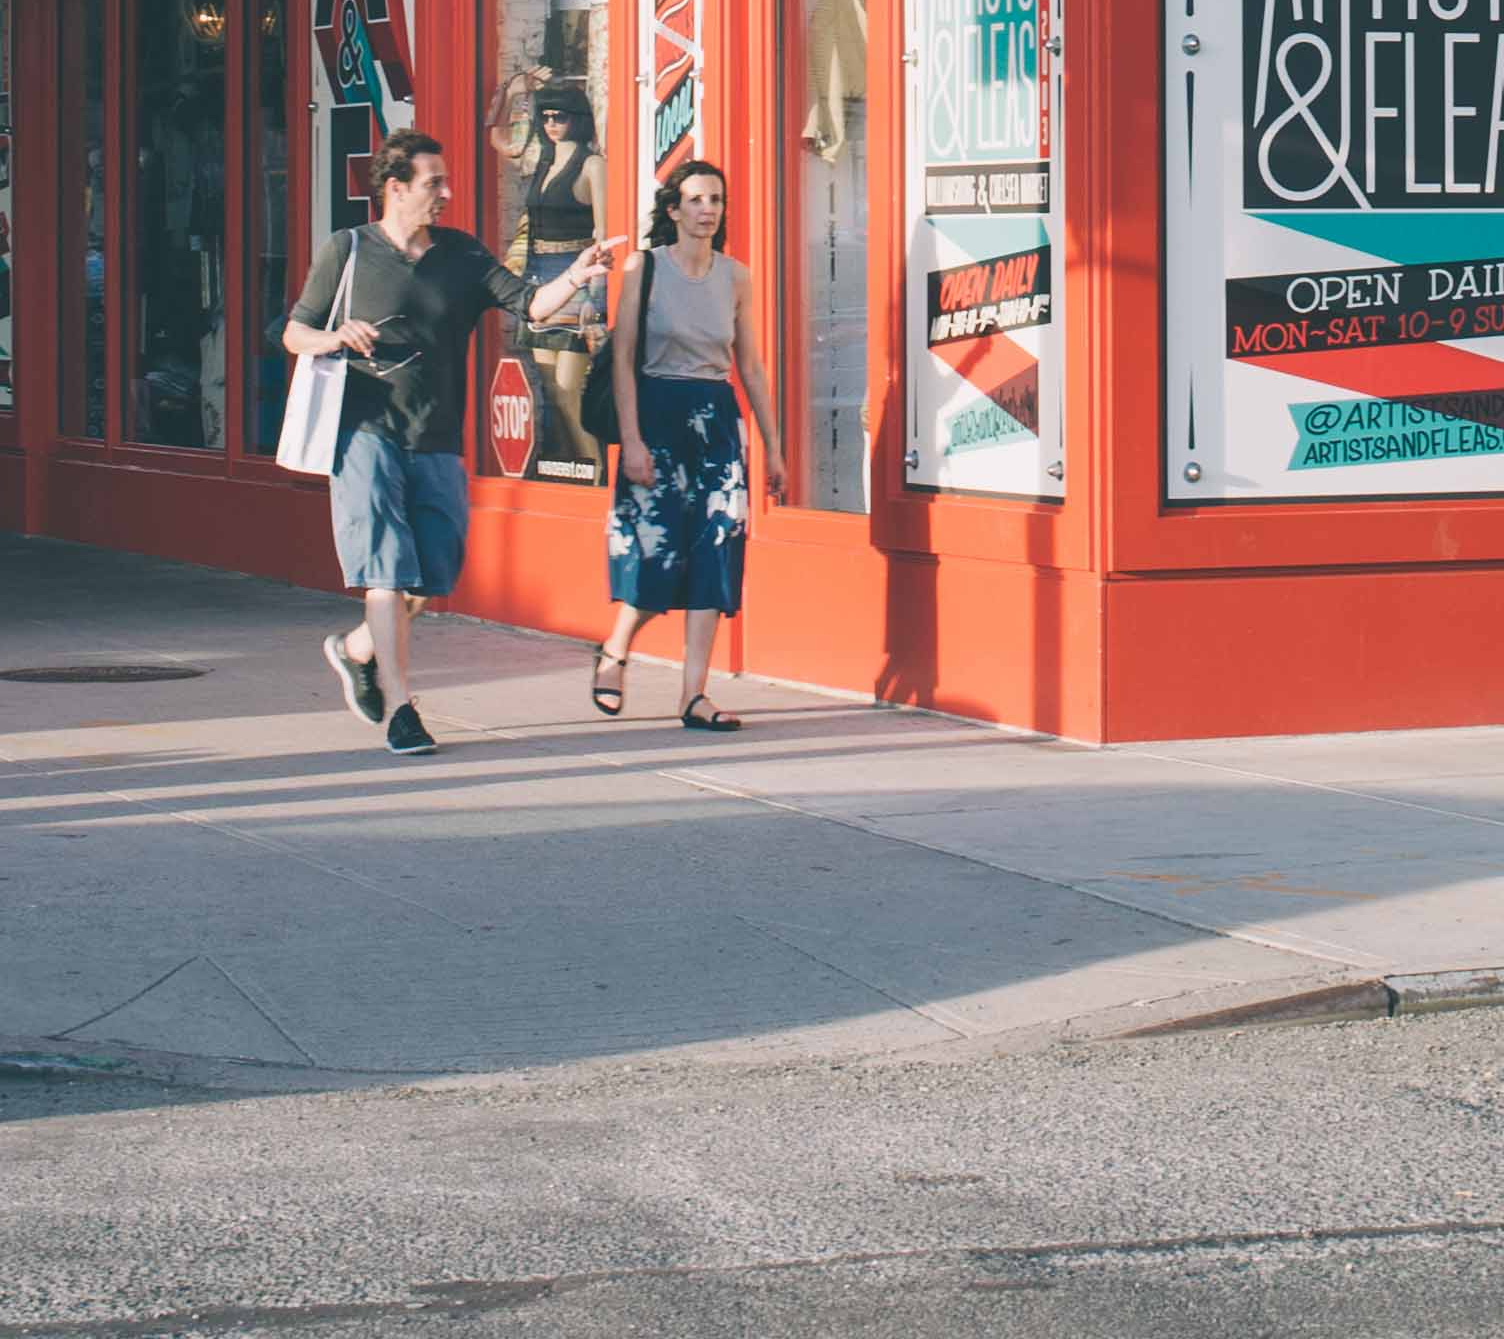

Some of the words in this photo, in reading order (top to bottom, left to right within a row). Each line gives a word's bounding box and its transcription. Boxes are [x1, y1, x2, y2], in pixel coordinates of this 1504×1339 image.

[963, 20, 1035, 154] FLEAS
[1258, 32, 1373, 209] &
[939, 264, 990, 311] OPEN
[991, 252, 1040, 302] DAILY
[1286, 273, 1403, 314] OPEN
[1398, 308, 1466, 340] 10-9
[493, 394, 530, 441] STOP
